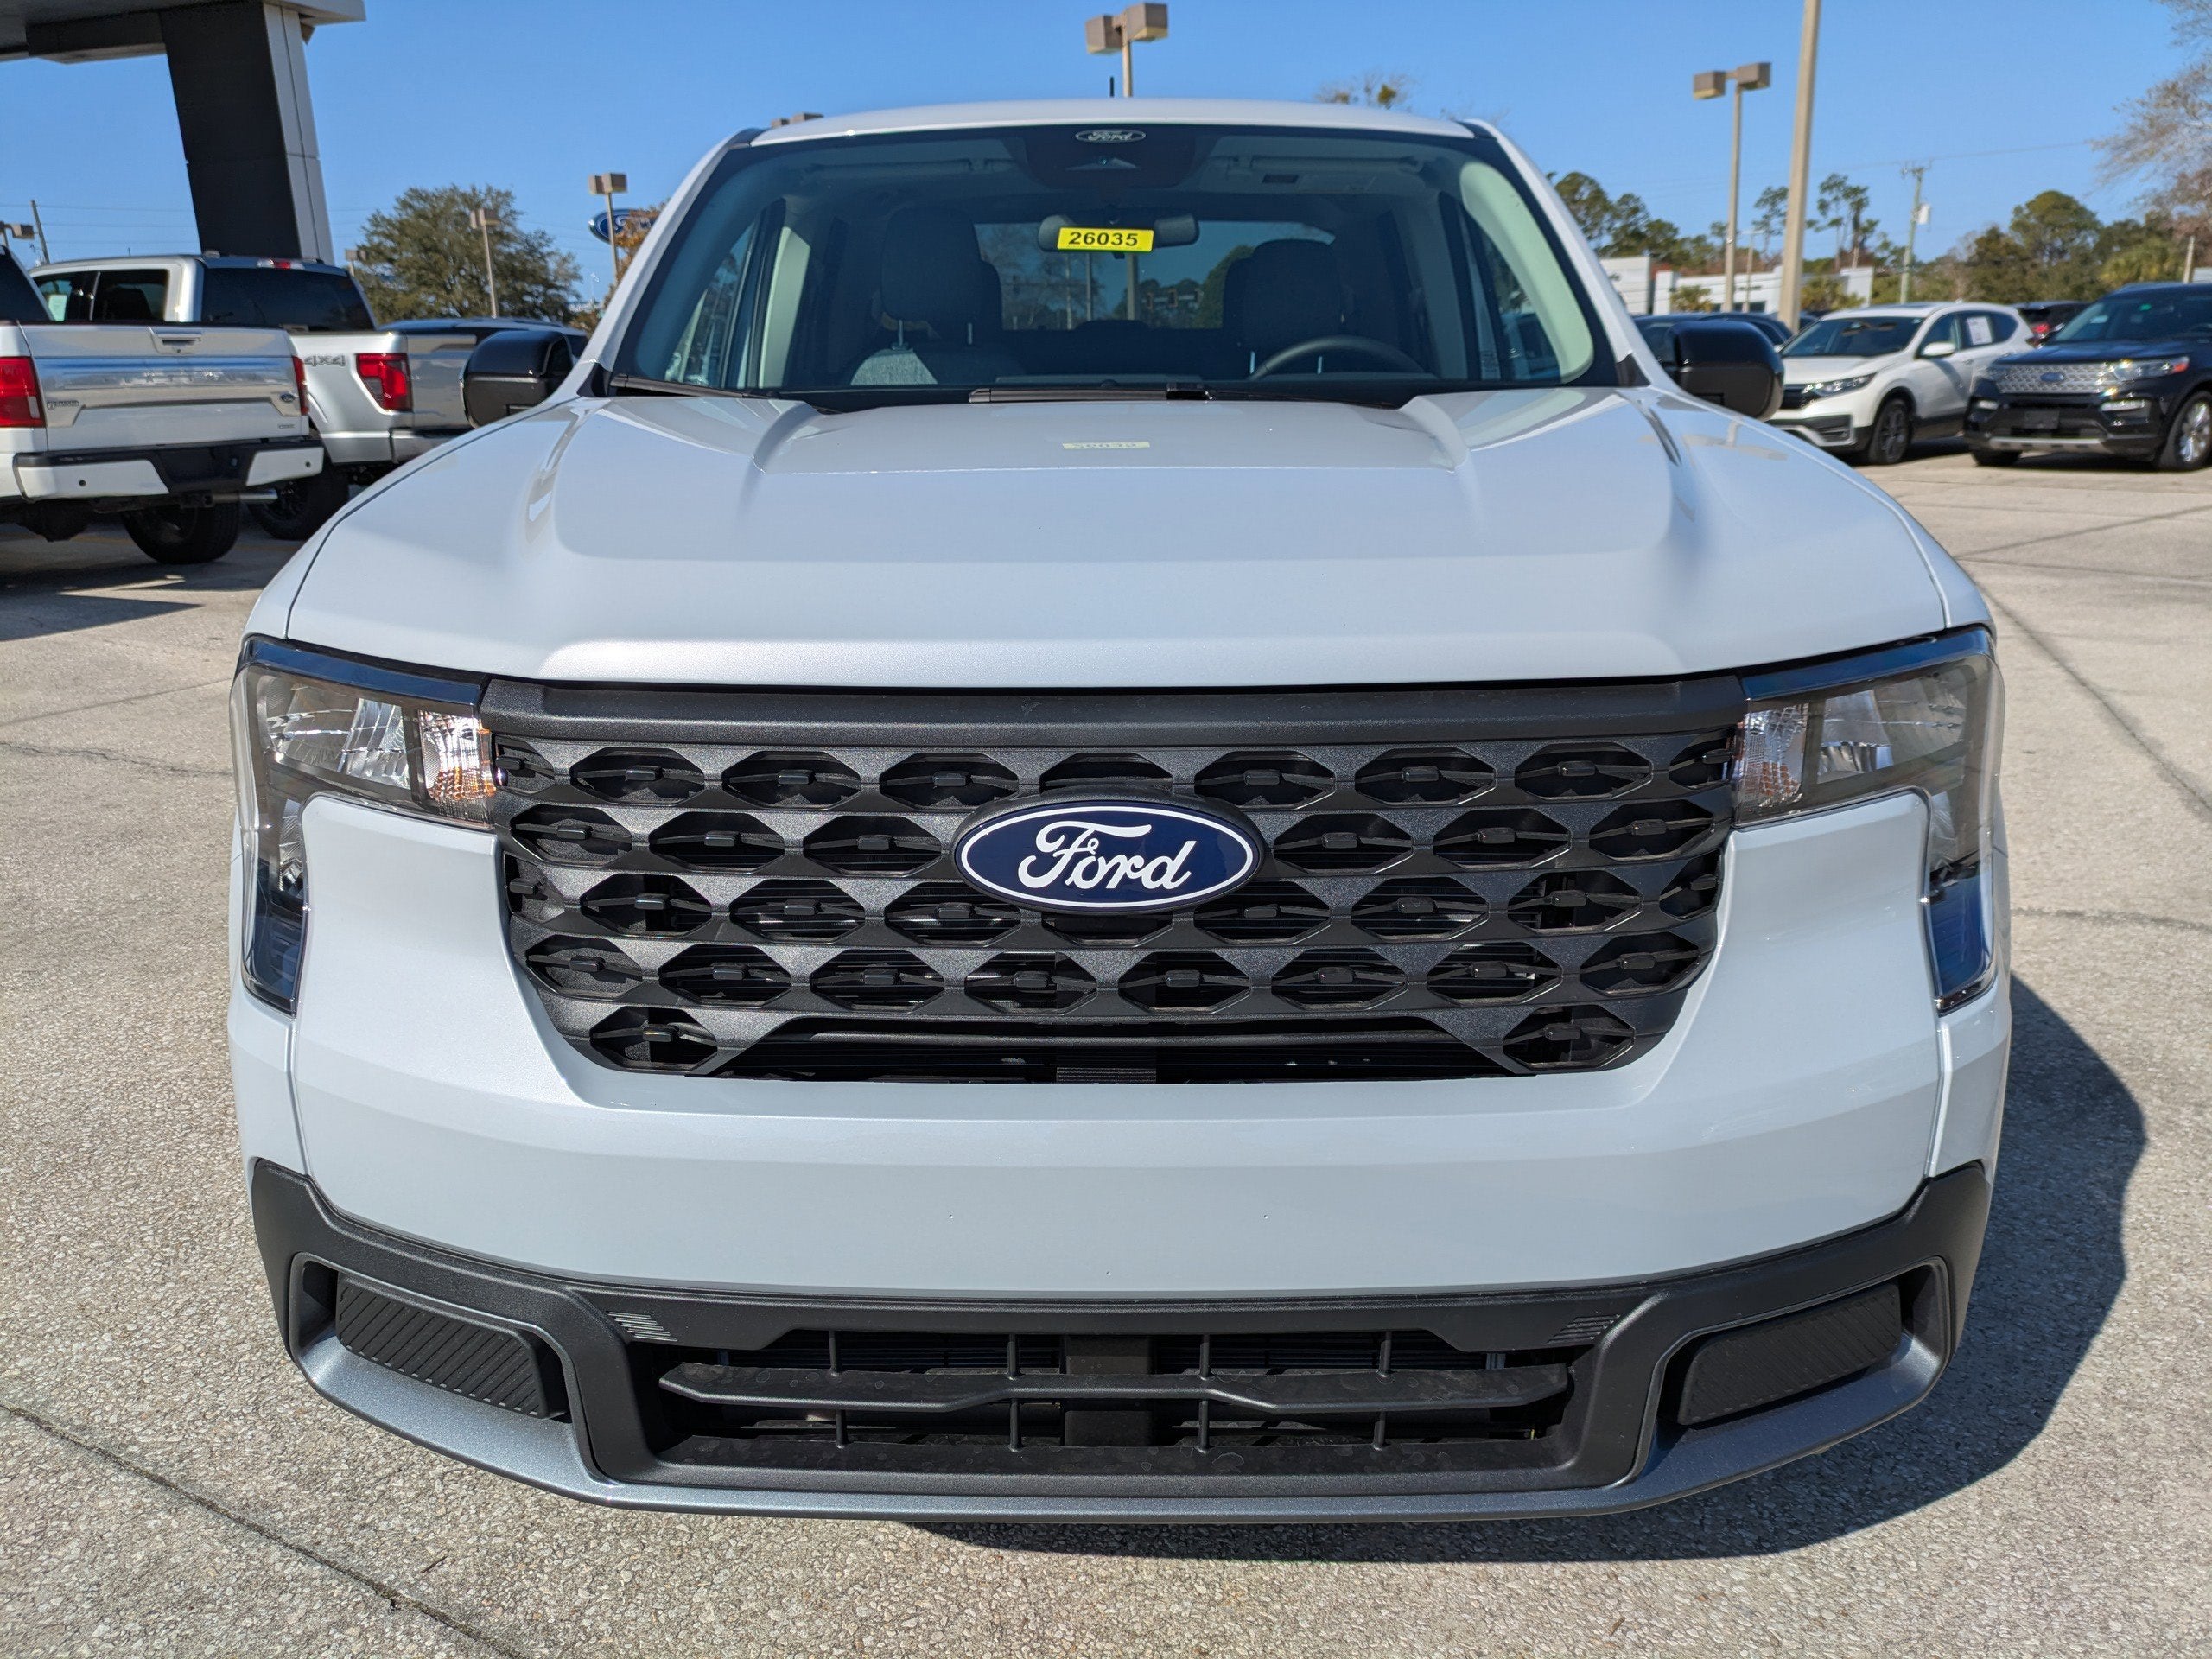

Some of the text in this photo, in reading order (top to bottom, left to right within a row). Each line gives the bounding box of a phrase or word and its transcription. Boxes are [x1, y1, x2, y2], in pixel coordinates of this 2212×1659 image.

[1087, 130, 1134, 141] Ford
[1068, 231, 1139, 247] 26035
[1017, 820, 1198, 890] Ford
